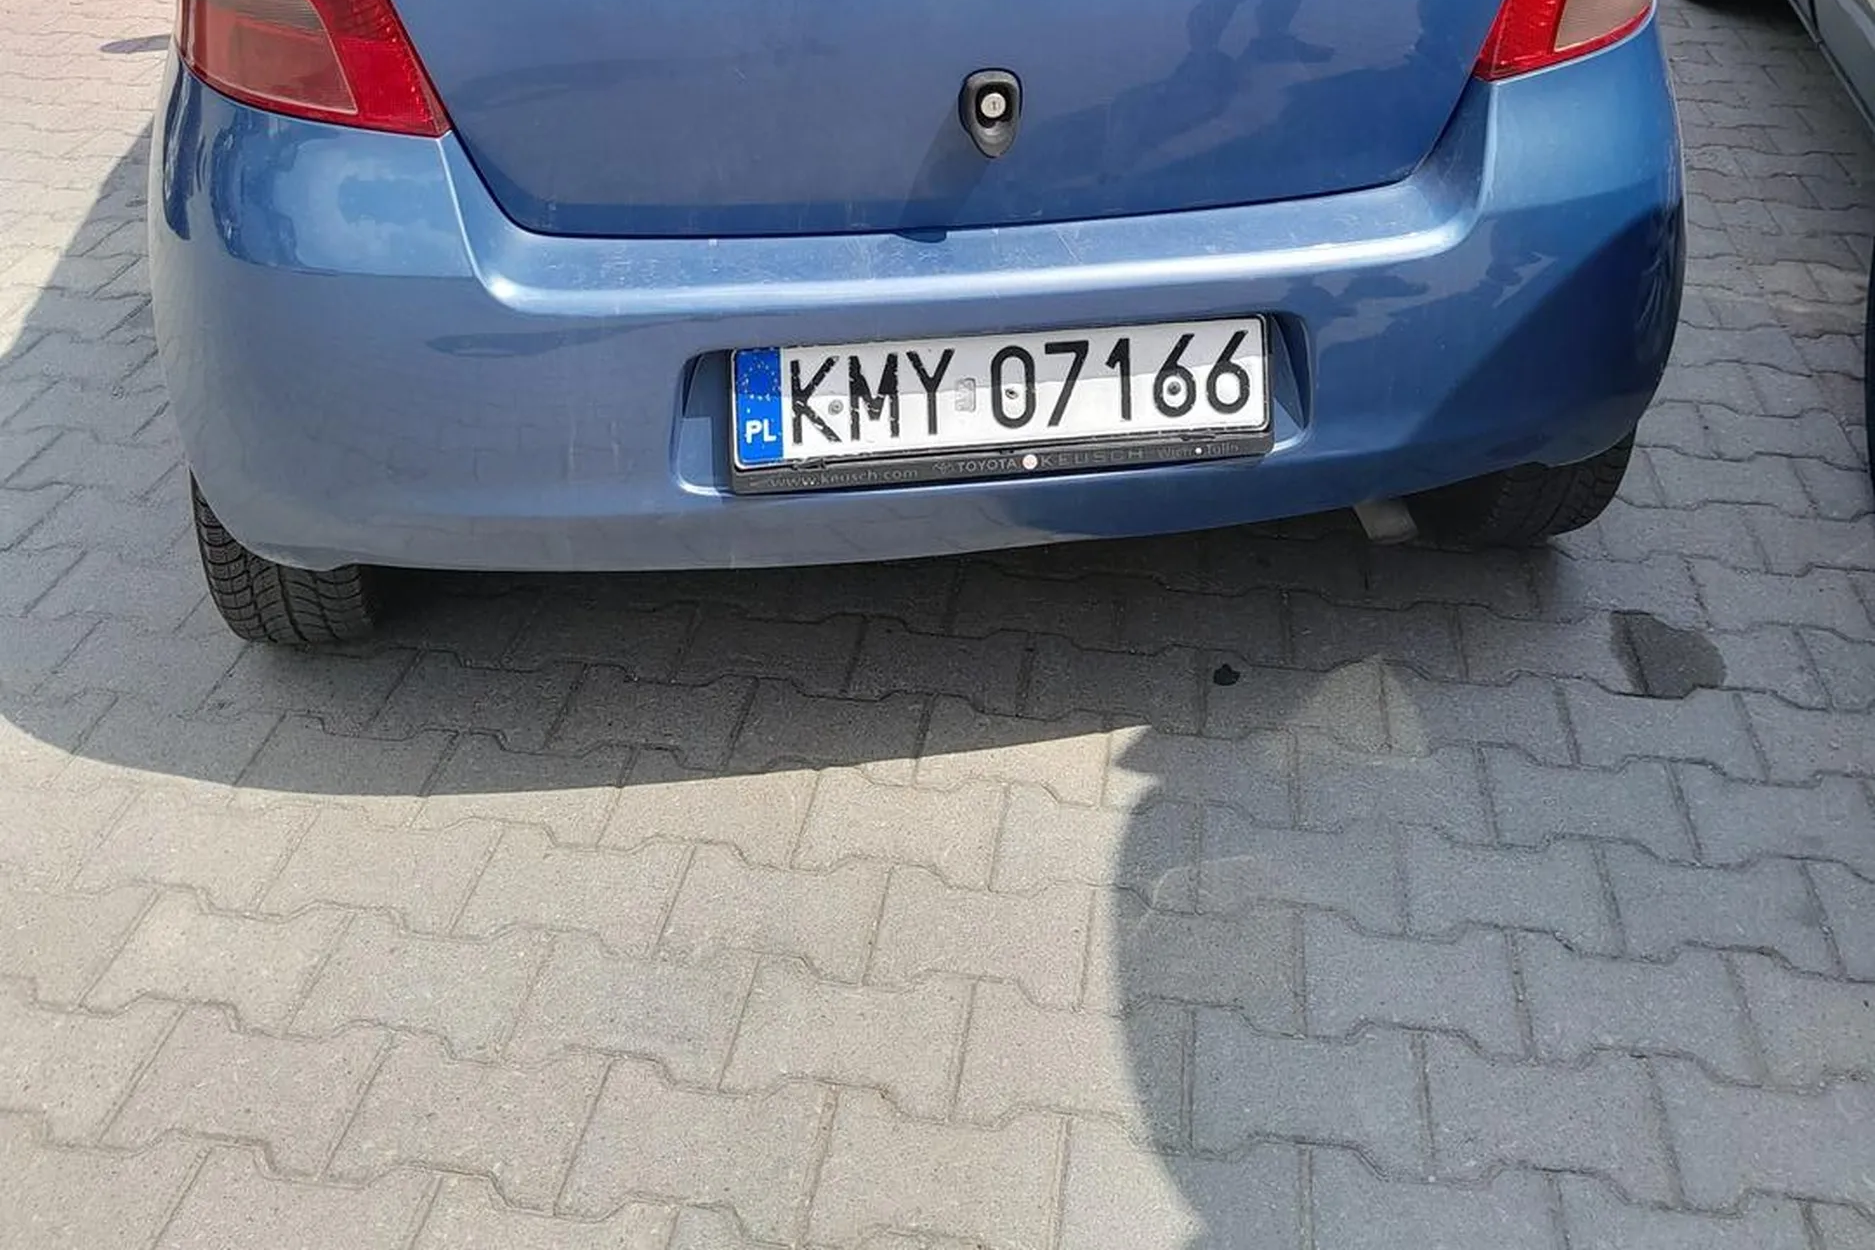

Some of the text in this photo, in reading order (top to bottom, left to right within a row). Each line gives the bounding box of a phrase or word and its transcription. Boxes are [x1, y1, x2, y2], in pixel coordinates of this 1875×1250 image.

[790, 330, 1251, 444] KMY 07166
[745, 418, 777, 444] PL
[958, 449, 1143, 472] TOYOTA KEUSCH
